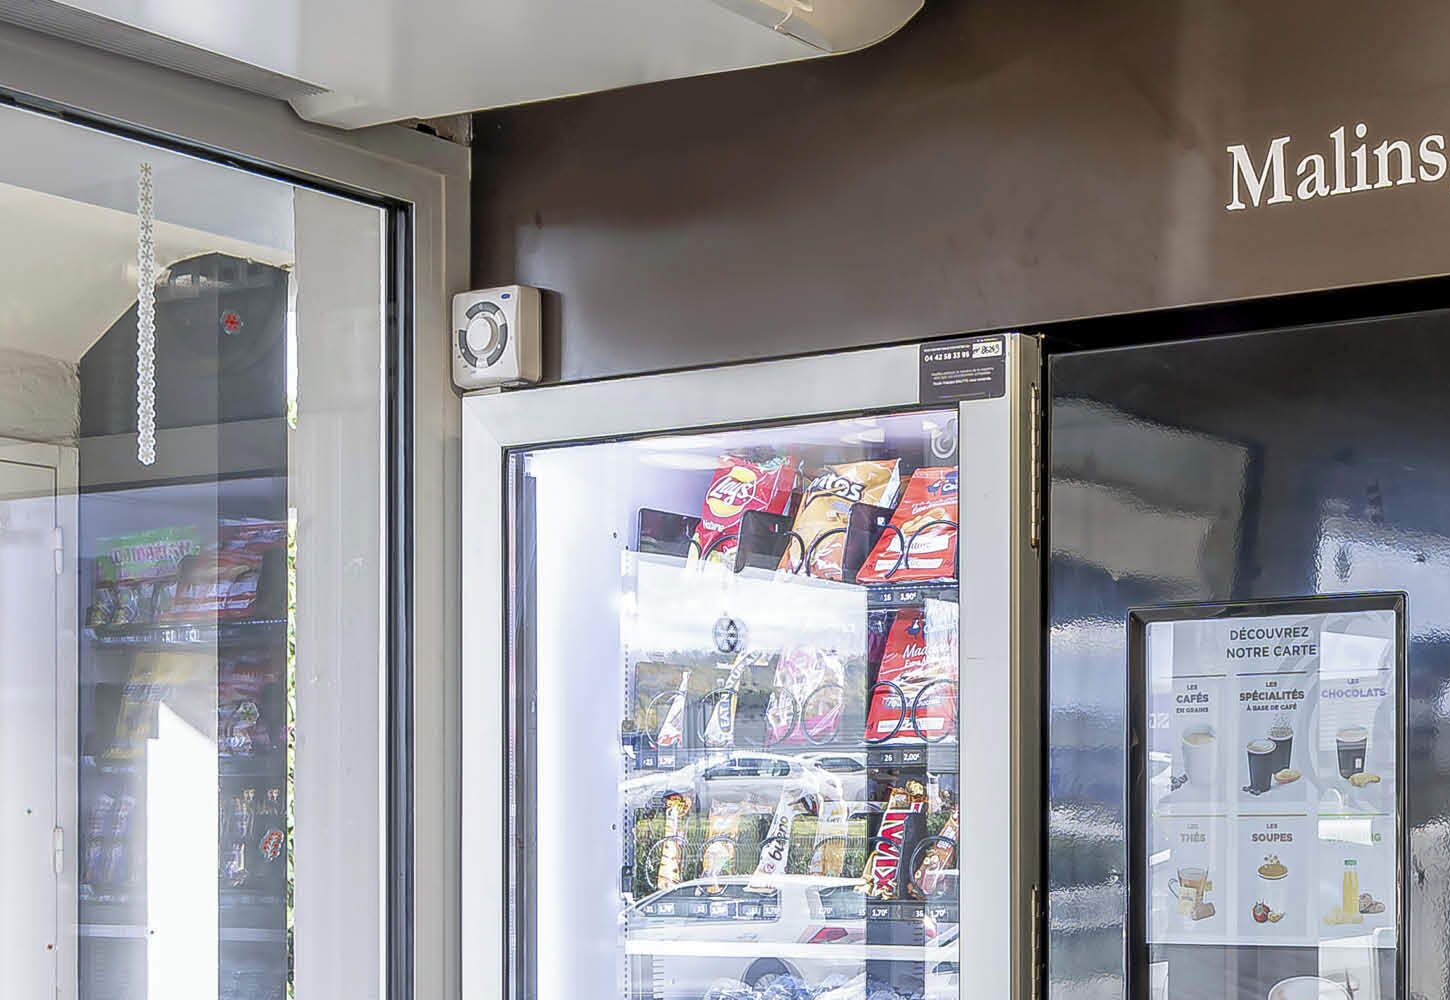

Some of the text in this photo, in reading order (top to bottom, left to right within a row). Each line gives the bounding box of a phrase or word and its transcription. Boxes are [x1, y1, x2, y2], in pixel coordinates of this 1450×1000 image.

[1230, 627, 1309, 641] DÉCOUVREZ
[1226, 644, 1317, 659] NOTRE CARTE
[1176, 693, 1209, 704] CAFÉS
[1239, 690, 1305, 702] SPÉCIALITÉS
[1321, 687, 1387, 699] CHOCOLATS
[1281, 702, 1297, 711] CAFÉ
[767, 815, 790, 862] bueno
[1251, 833, 1293, 843] SOUPES
